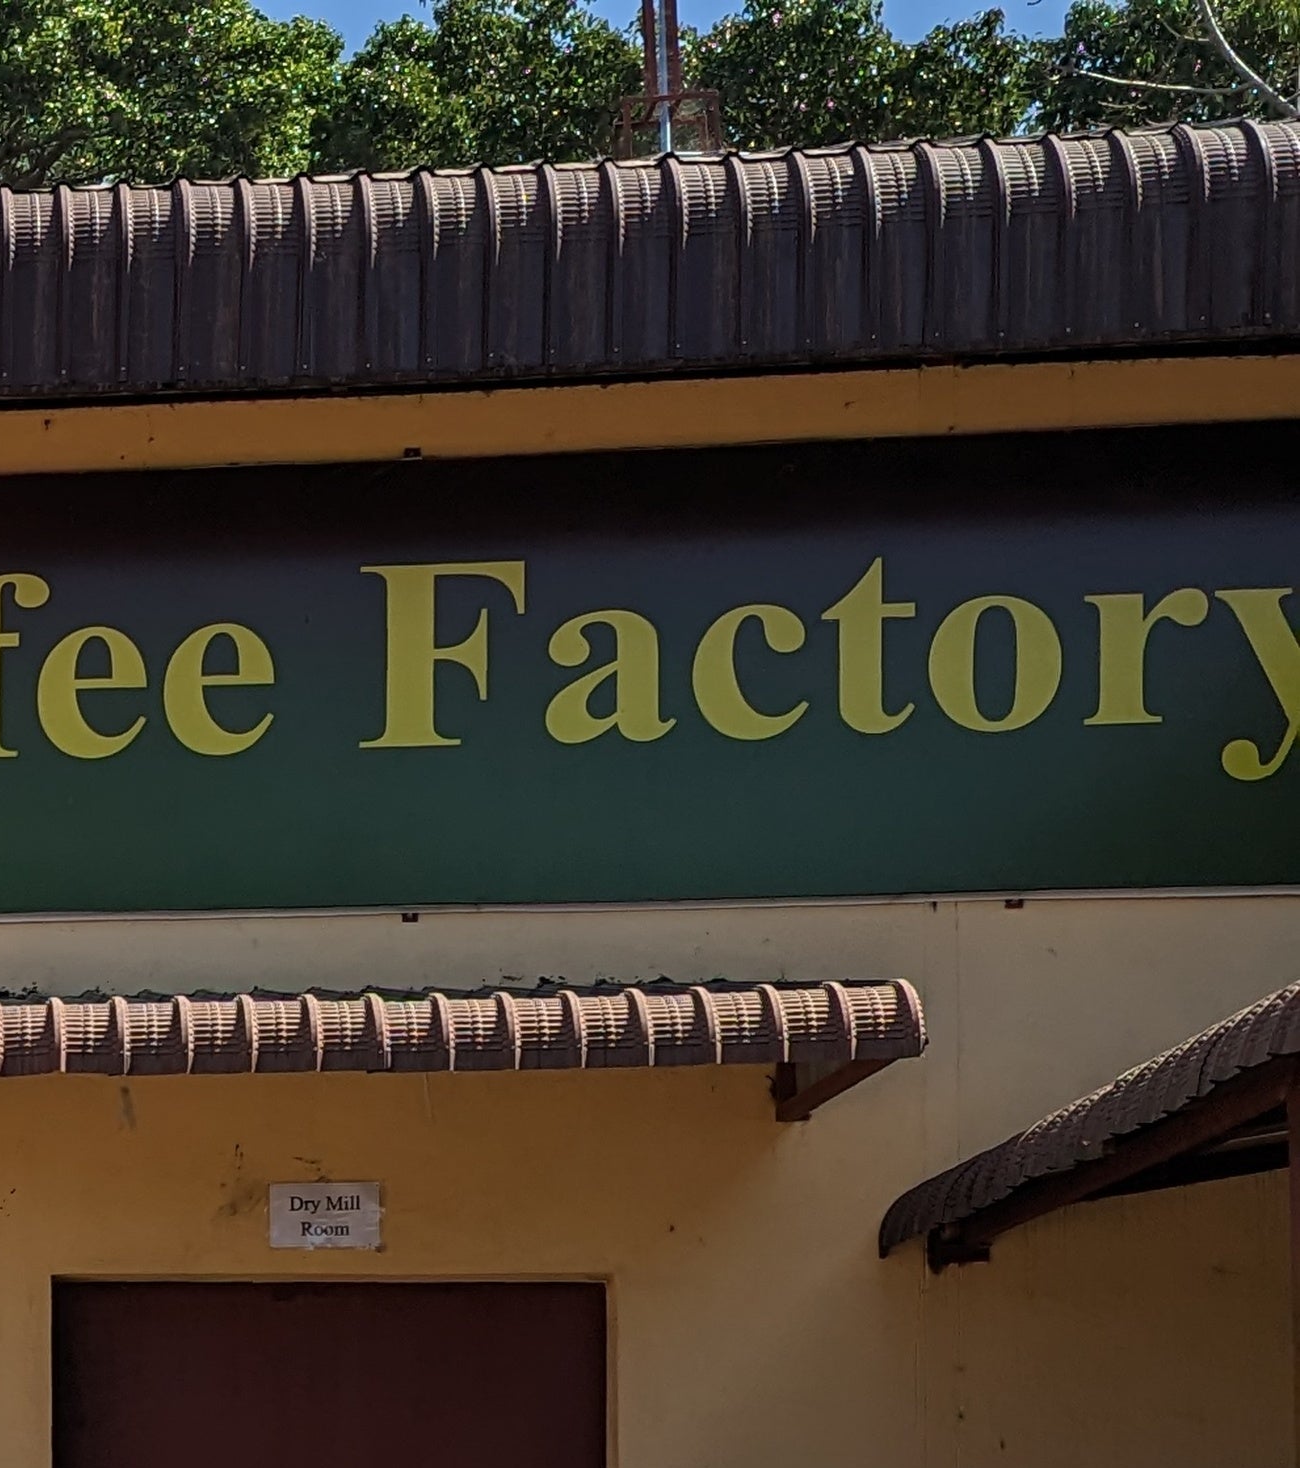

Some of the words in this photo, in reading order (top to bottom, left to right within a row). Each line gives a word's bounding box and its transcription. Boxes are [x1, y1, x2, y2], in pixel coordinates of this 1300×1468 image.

[359, 557, 1300, 781] Factory
[289, 1196, 320, 1214] Dry
[326, 1195, 361, 1211] Mill
[301, 1221, 349, 1237] Room
